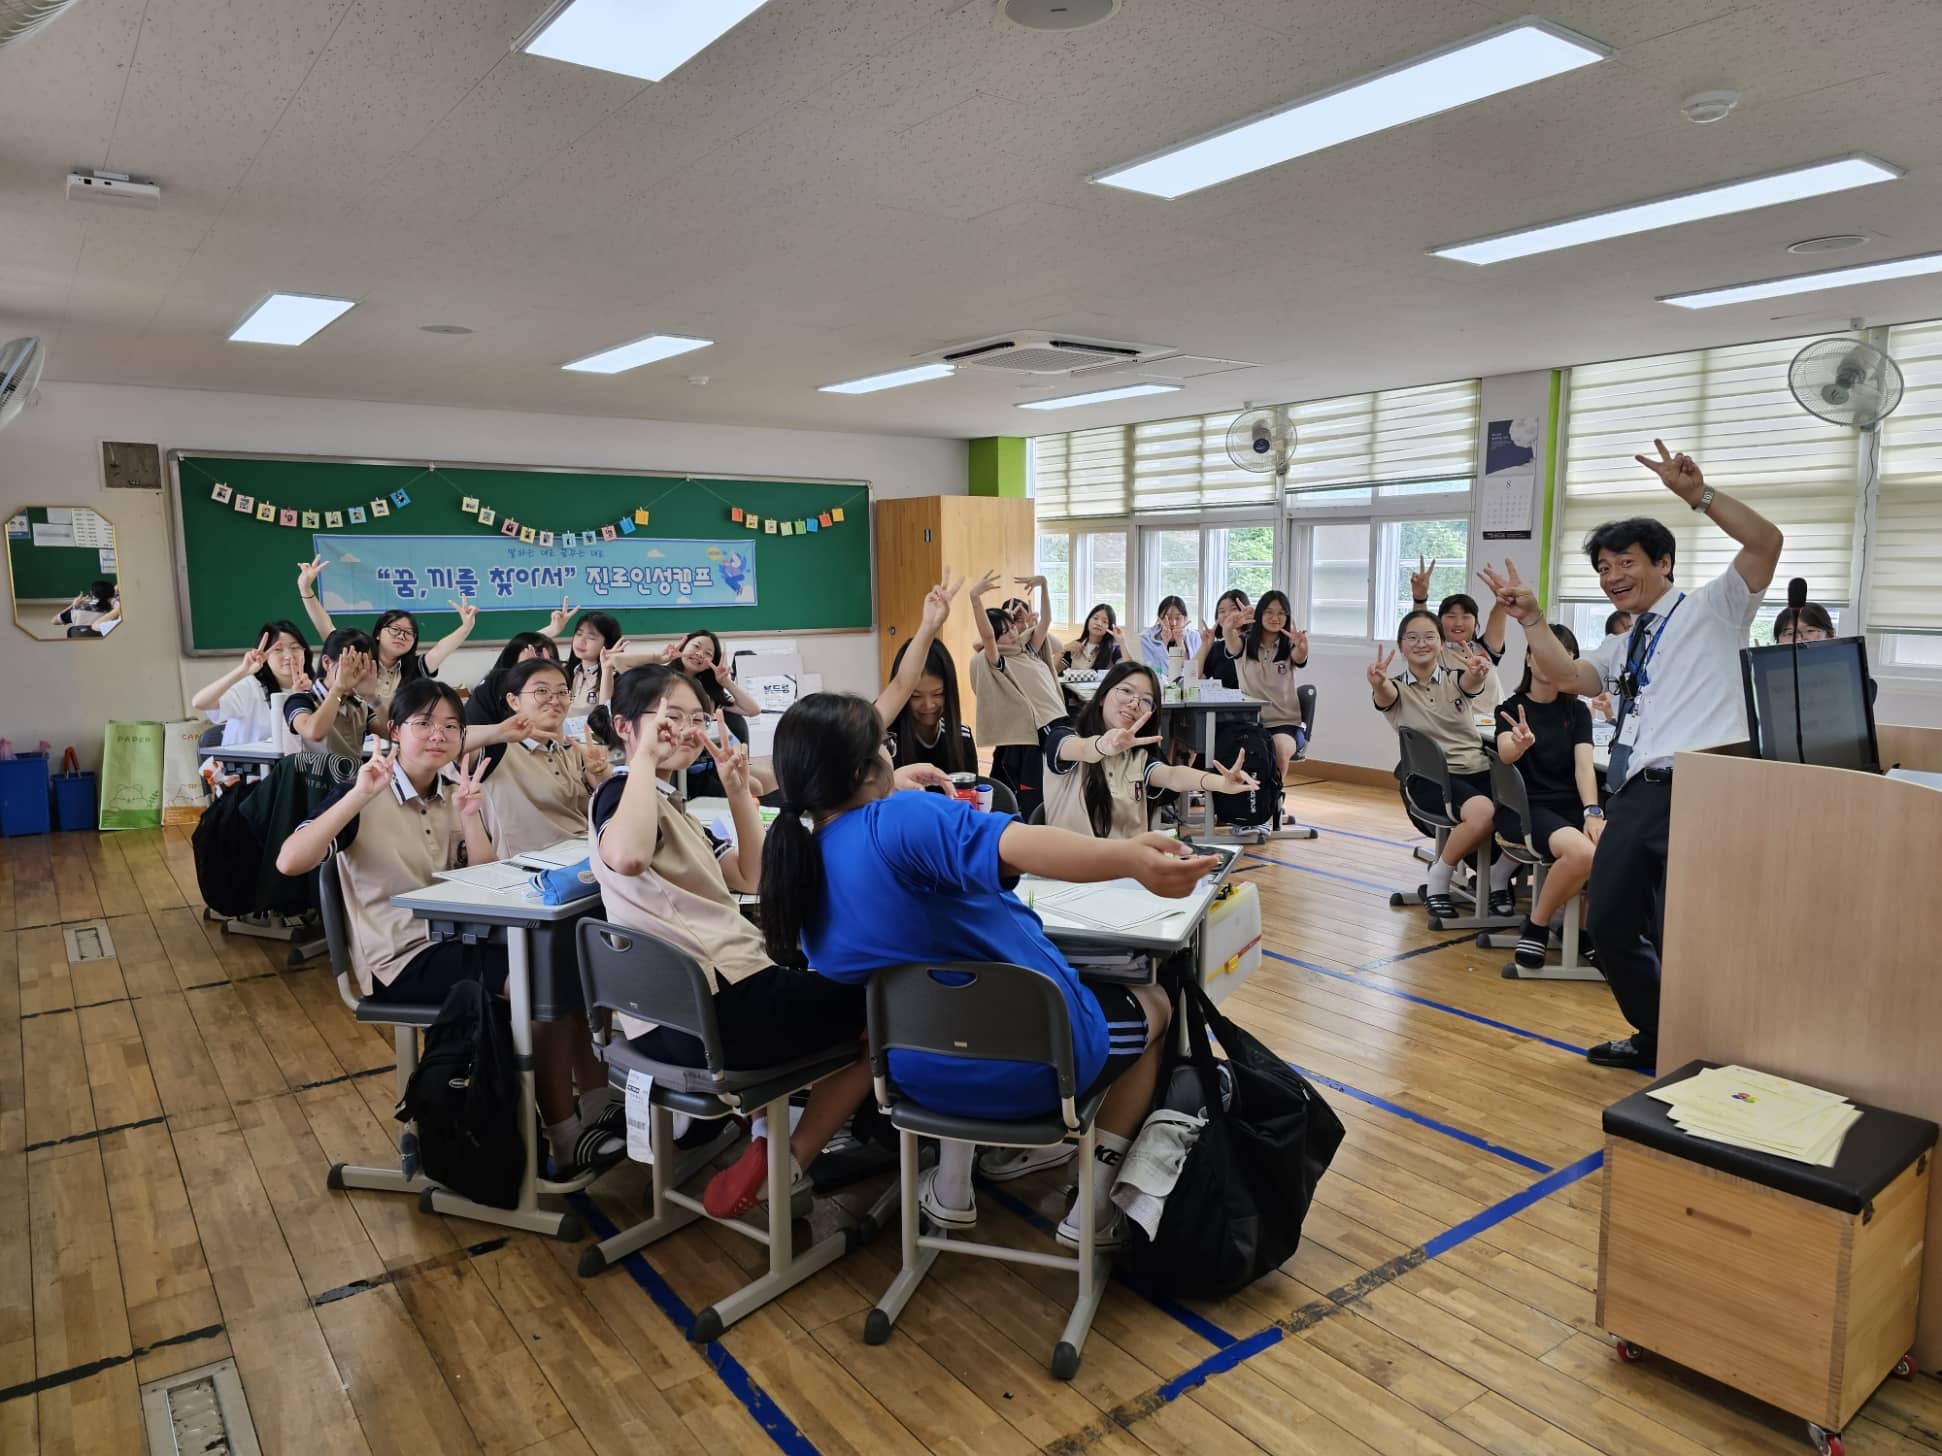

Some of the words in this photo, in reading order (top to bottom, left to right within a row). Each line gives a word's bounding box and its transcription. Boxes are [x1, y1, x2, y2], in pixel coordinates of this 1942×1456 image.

[1505, 479, 1512, 489] 8
[488, 566, 577, 597] 찾아서”
[585, 566, 713, 596] 진로인성캠프
